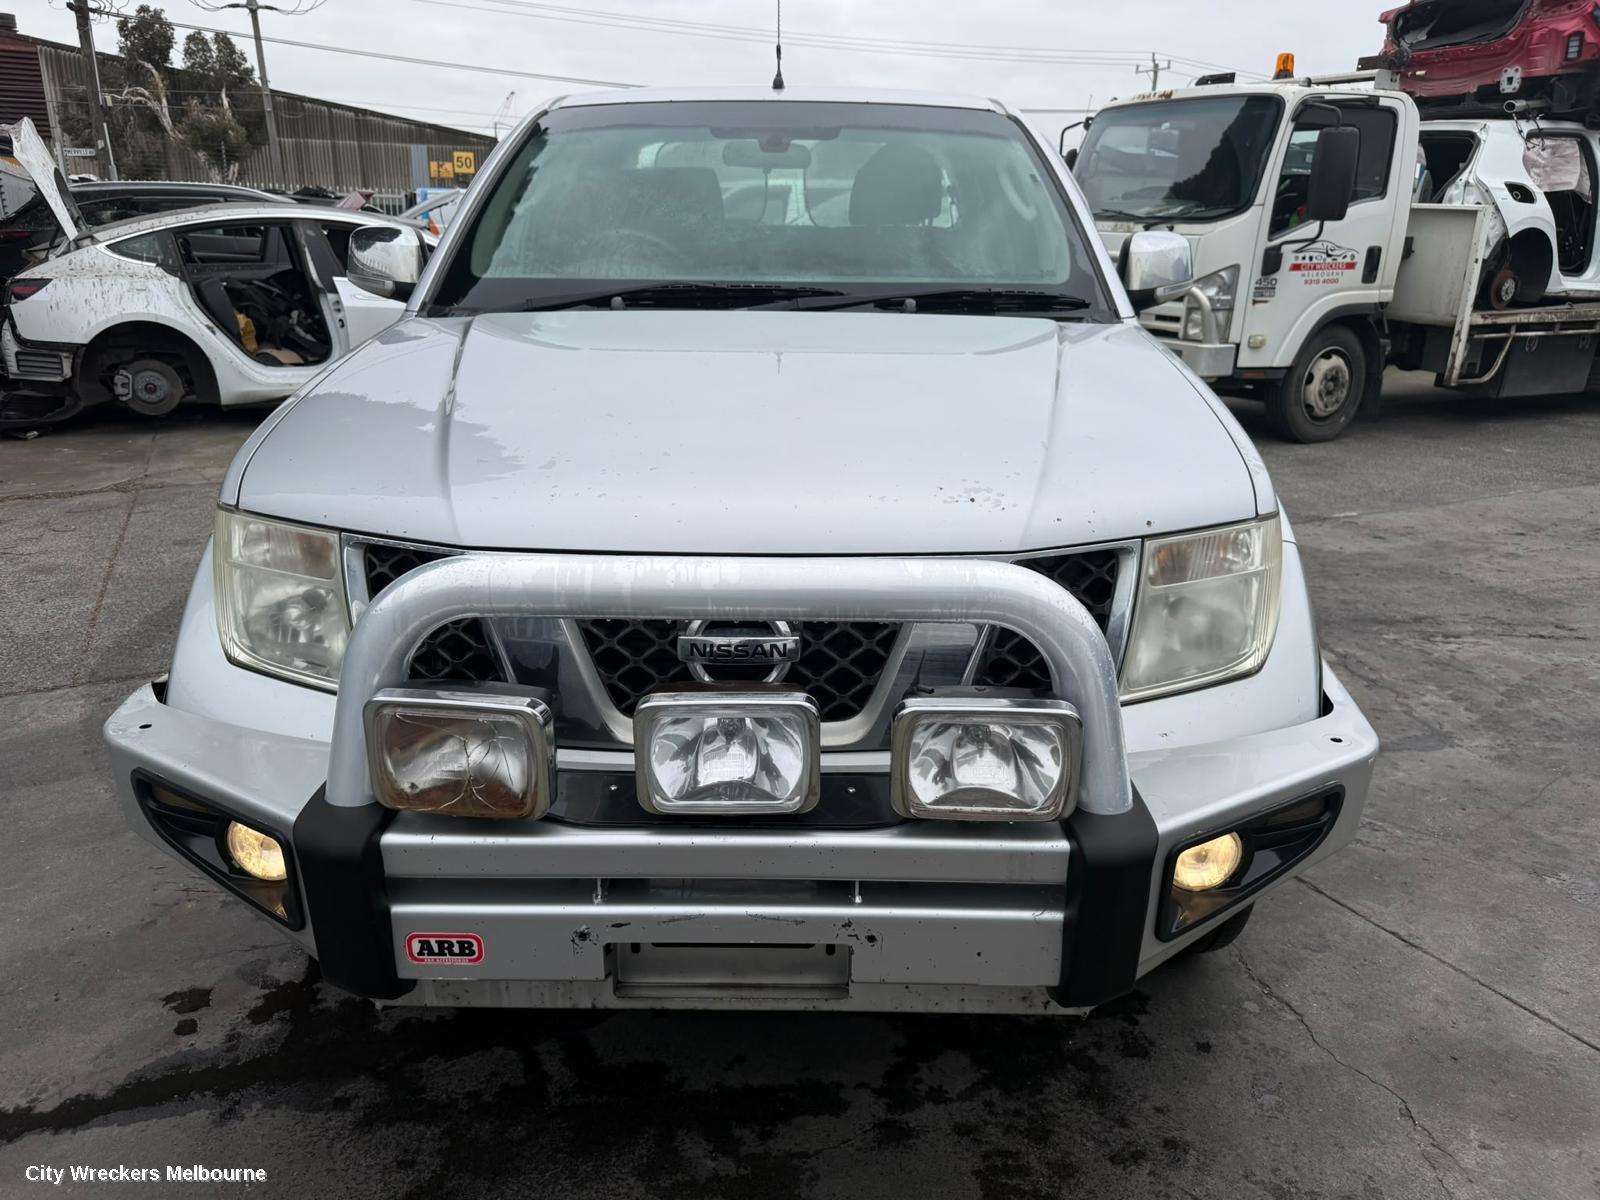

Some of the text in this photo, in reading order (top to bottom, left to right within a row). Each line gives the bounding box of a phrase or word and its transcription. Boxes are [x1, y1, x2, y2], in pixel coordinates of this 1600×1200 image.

[456, 156, 472, 169] 50
[1315, 262, 1346, 270] WRECKERS
[1255, 278, 1277, 286] 450
[689, 643, 788, 658] NISSAN
[417, 939, 475, 956] ARB
